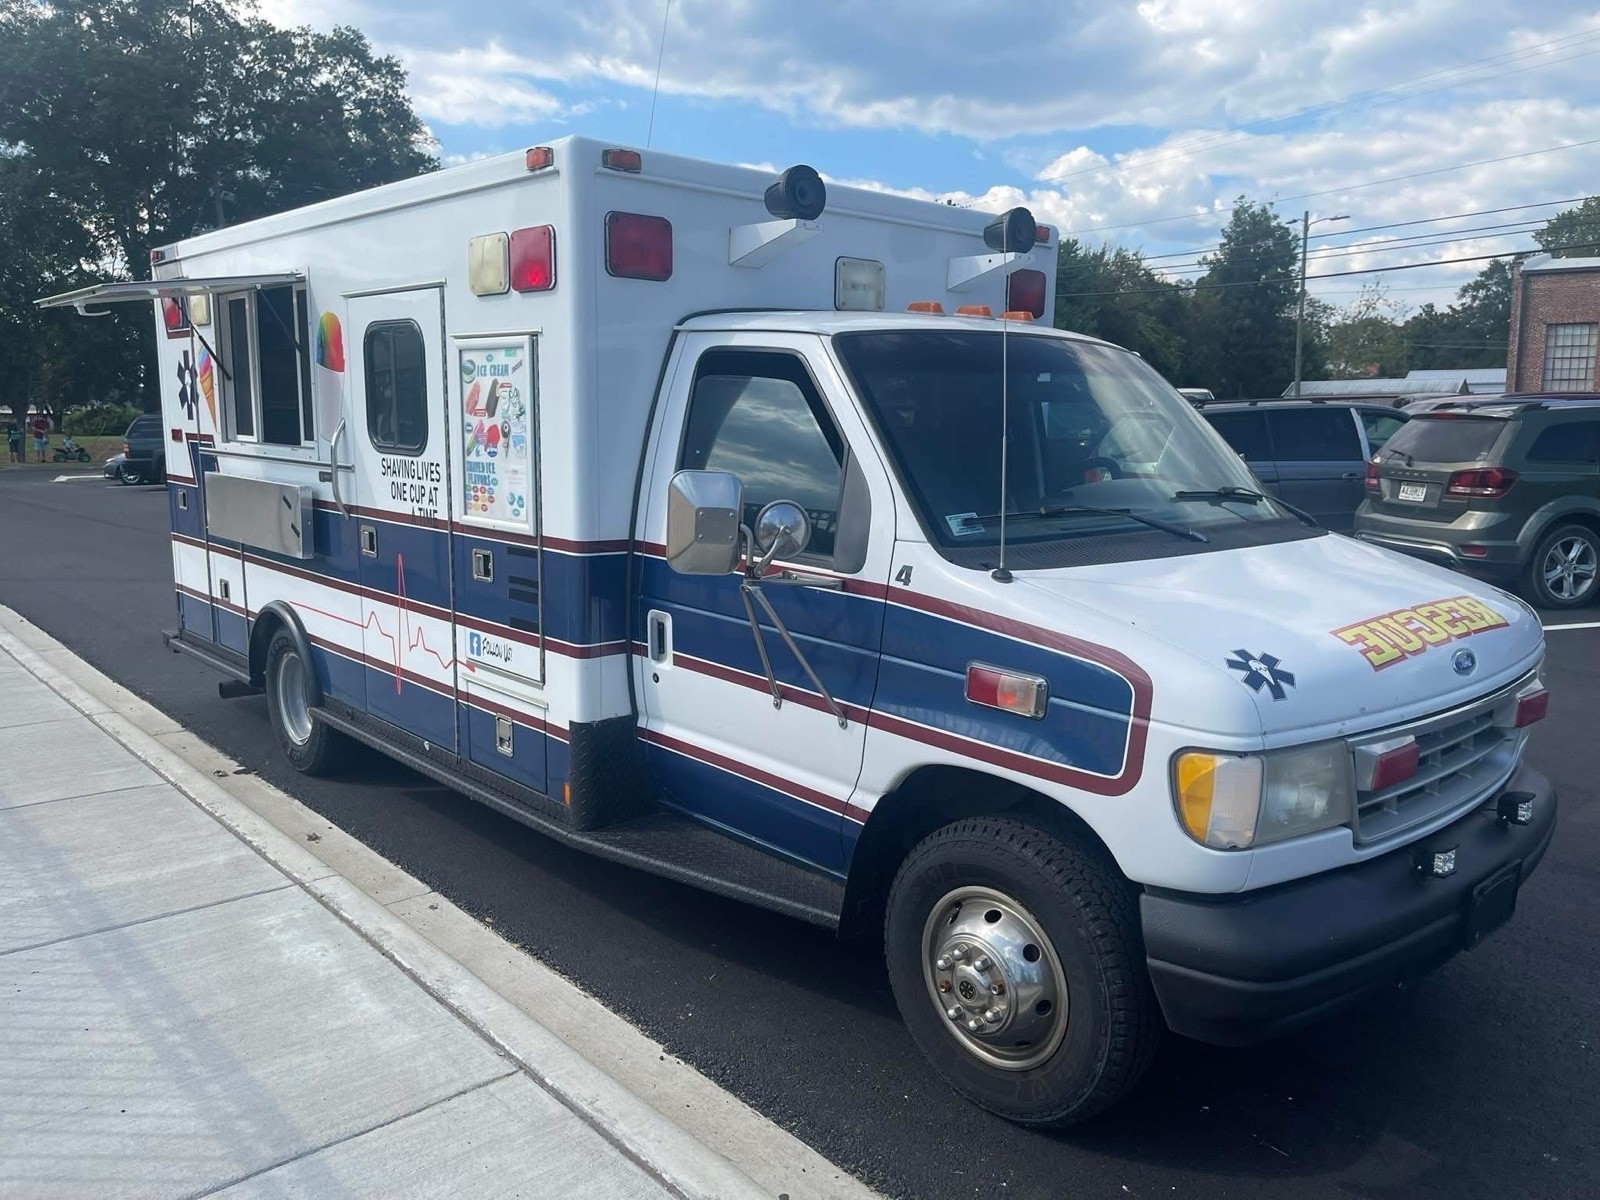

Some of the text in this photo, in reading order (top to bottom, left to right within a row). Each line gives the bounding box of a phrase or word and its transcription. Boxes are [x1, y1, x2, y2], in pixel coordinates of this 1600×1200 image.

[477, 364, 487, 377] ICE
[490, 364, 509, 376] CREAM
[381, 457, 441, 483] SHAVING LIVES
[391, 481, 439, 506] ONE CUP AT
[895, 564, 913, 586] 4
